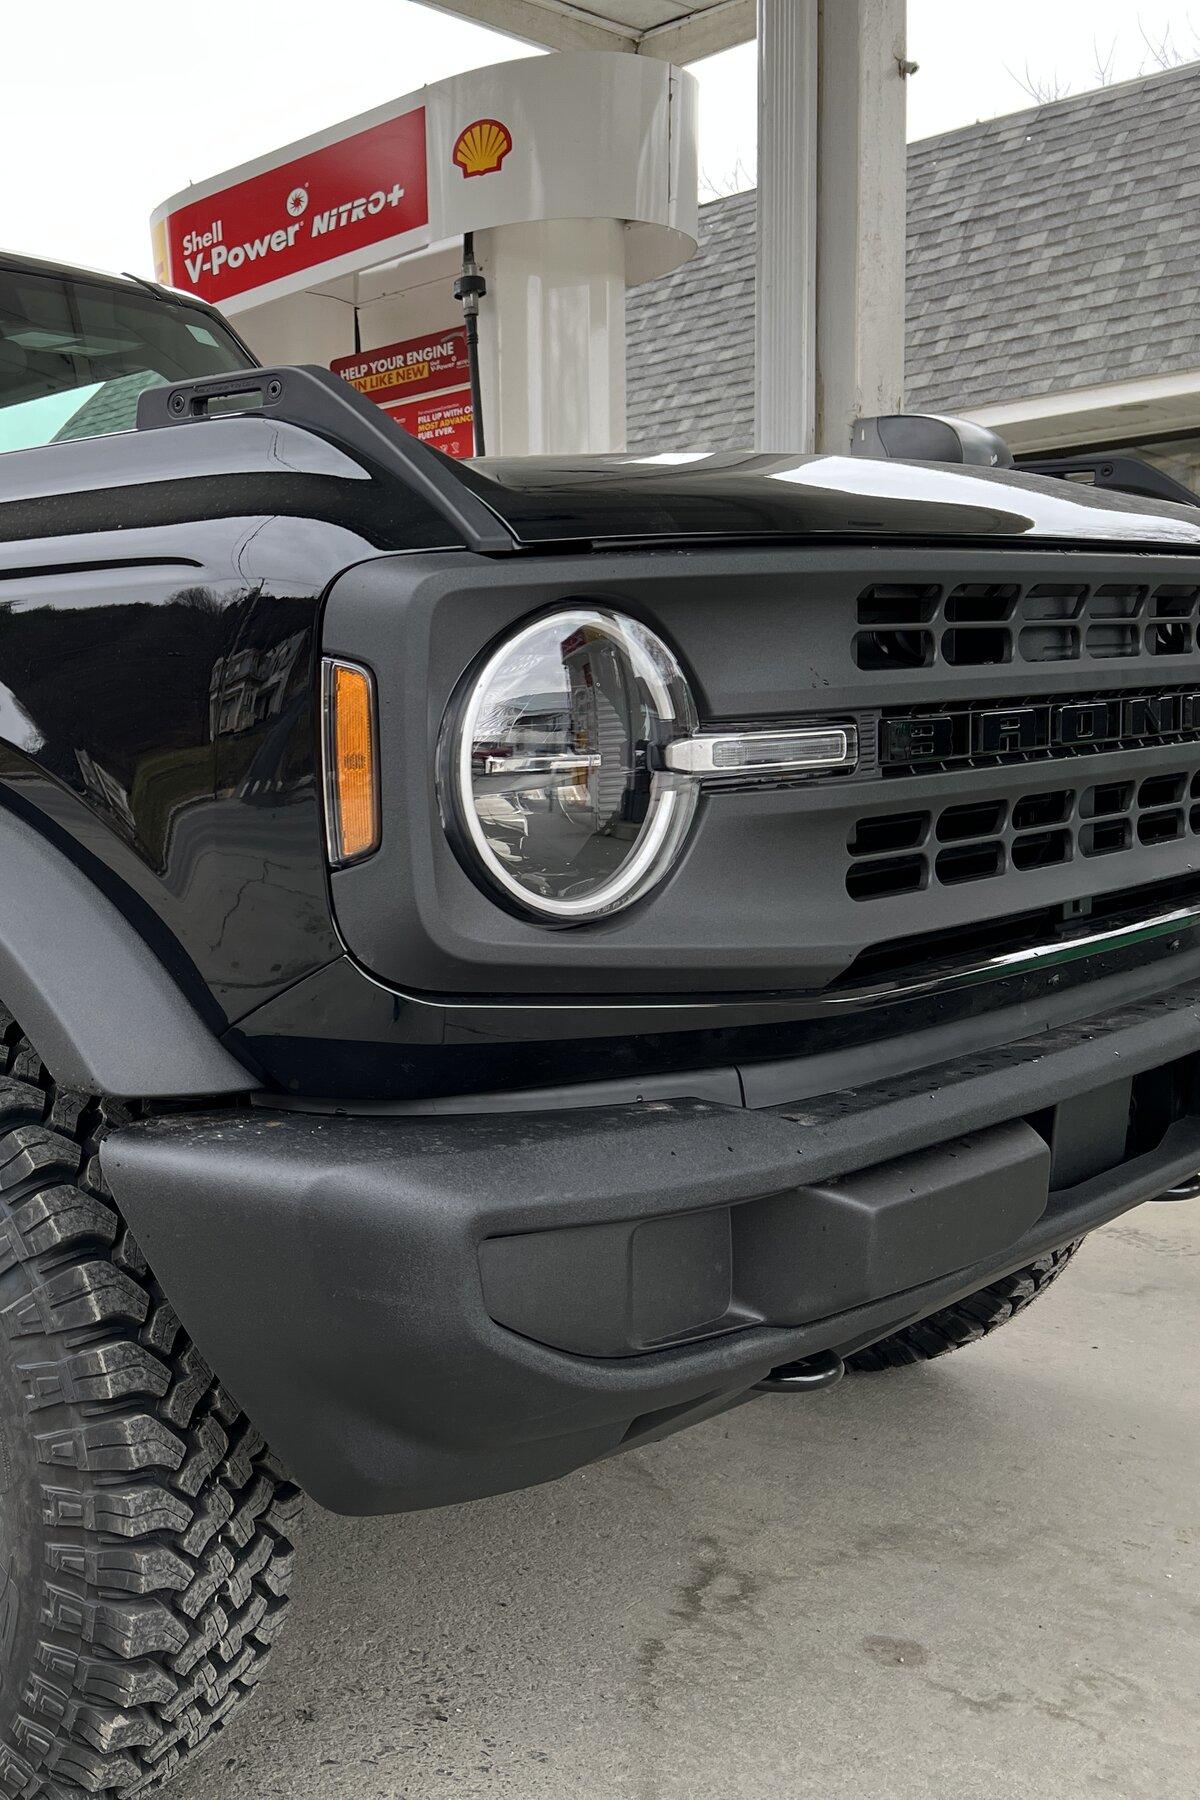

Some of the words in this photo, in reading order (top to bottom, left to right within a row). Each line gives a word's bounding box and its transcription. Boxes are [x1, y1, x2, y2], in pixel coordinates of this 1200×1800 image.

[182, 219, 224, 257] Shell
[184, 223, 300, 285] V-Power
[339, 363, 369, 381] HELP
[369, 354, 406, 375] YOUR
[406, 341, 455, 364] ENGINE
[369, 372, 394, 389] LIKE
[395, 366, 426, 383] NEW
[417, 414, 432, 424] FILL
[431, 412, 442, 421] UP
[442, 407, 463, 419] WITH
[417, 421, 439, 432] MOST
[439, 413, 474, 428] ADVANC
[417, 430, 434, 440] FUEL
